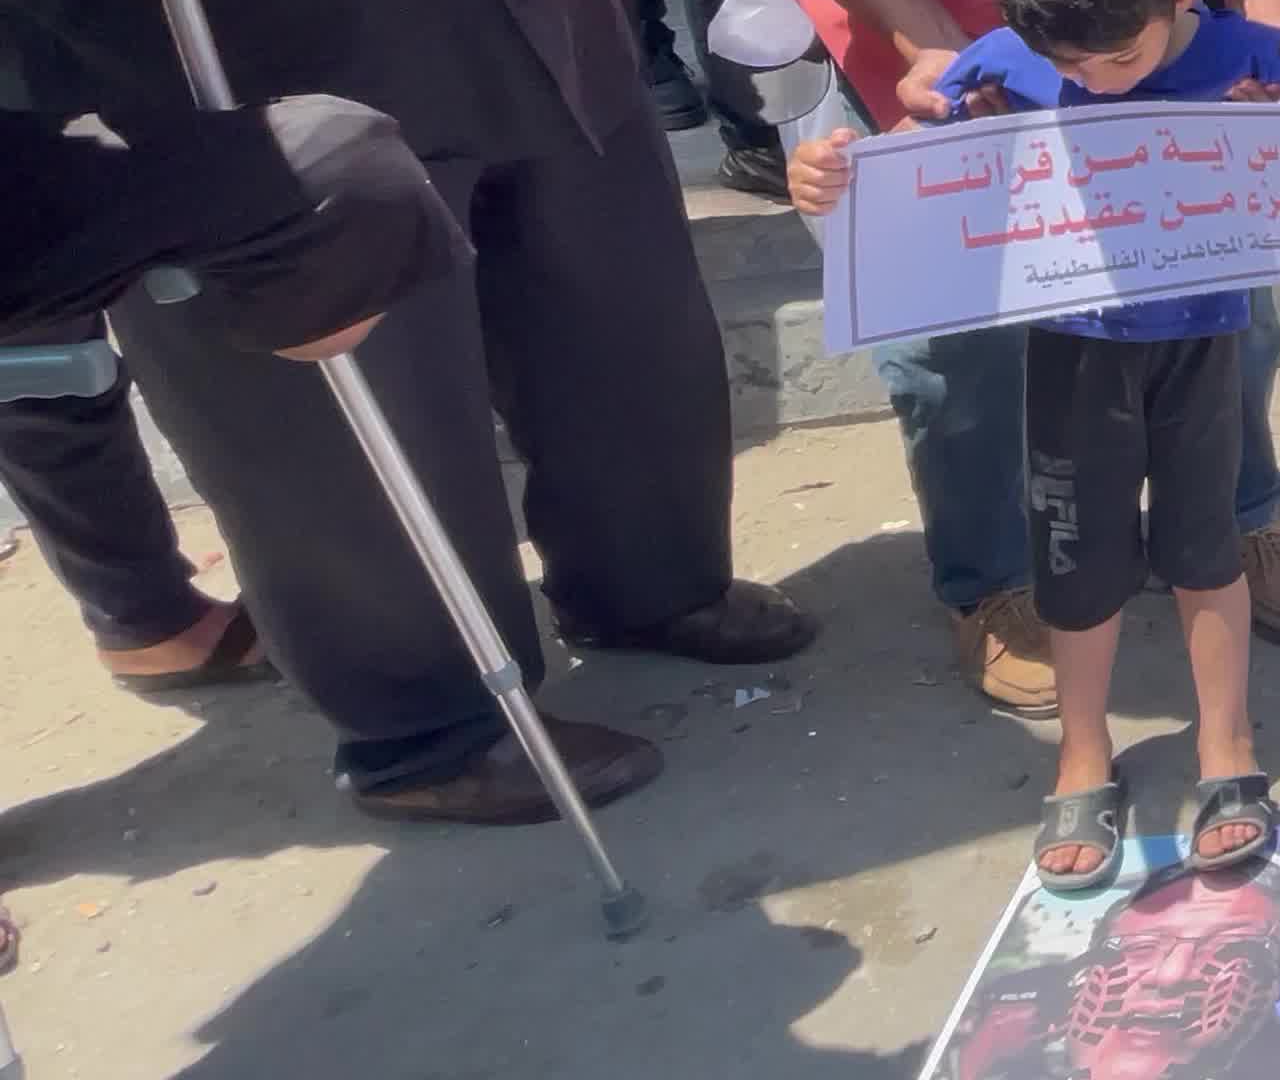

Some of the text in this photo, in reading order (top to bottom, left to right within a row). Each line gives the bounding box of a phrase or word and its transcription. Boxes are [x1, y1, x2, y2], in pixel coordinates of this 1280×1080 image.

[1067, 141, 1149, 188] من
[960, 191, 1146, 250] عقيدتنا
[1160, 188, 1236, 231] من
[1022, 250, 1146, 286] الفلسطينية
[1151, 237, 1245, 272] المجاهدين
[1047, 497, 1080, 577] FILA
